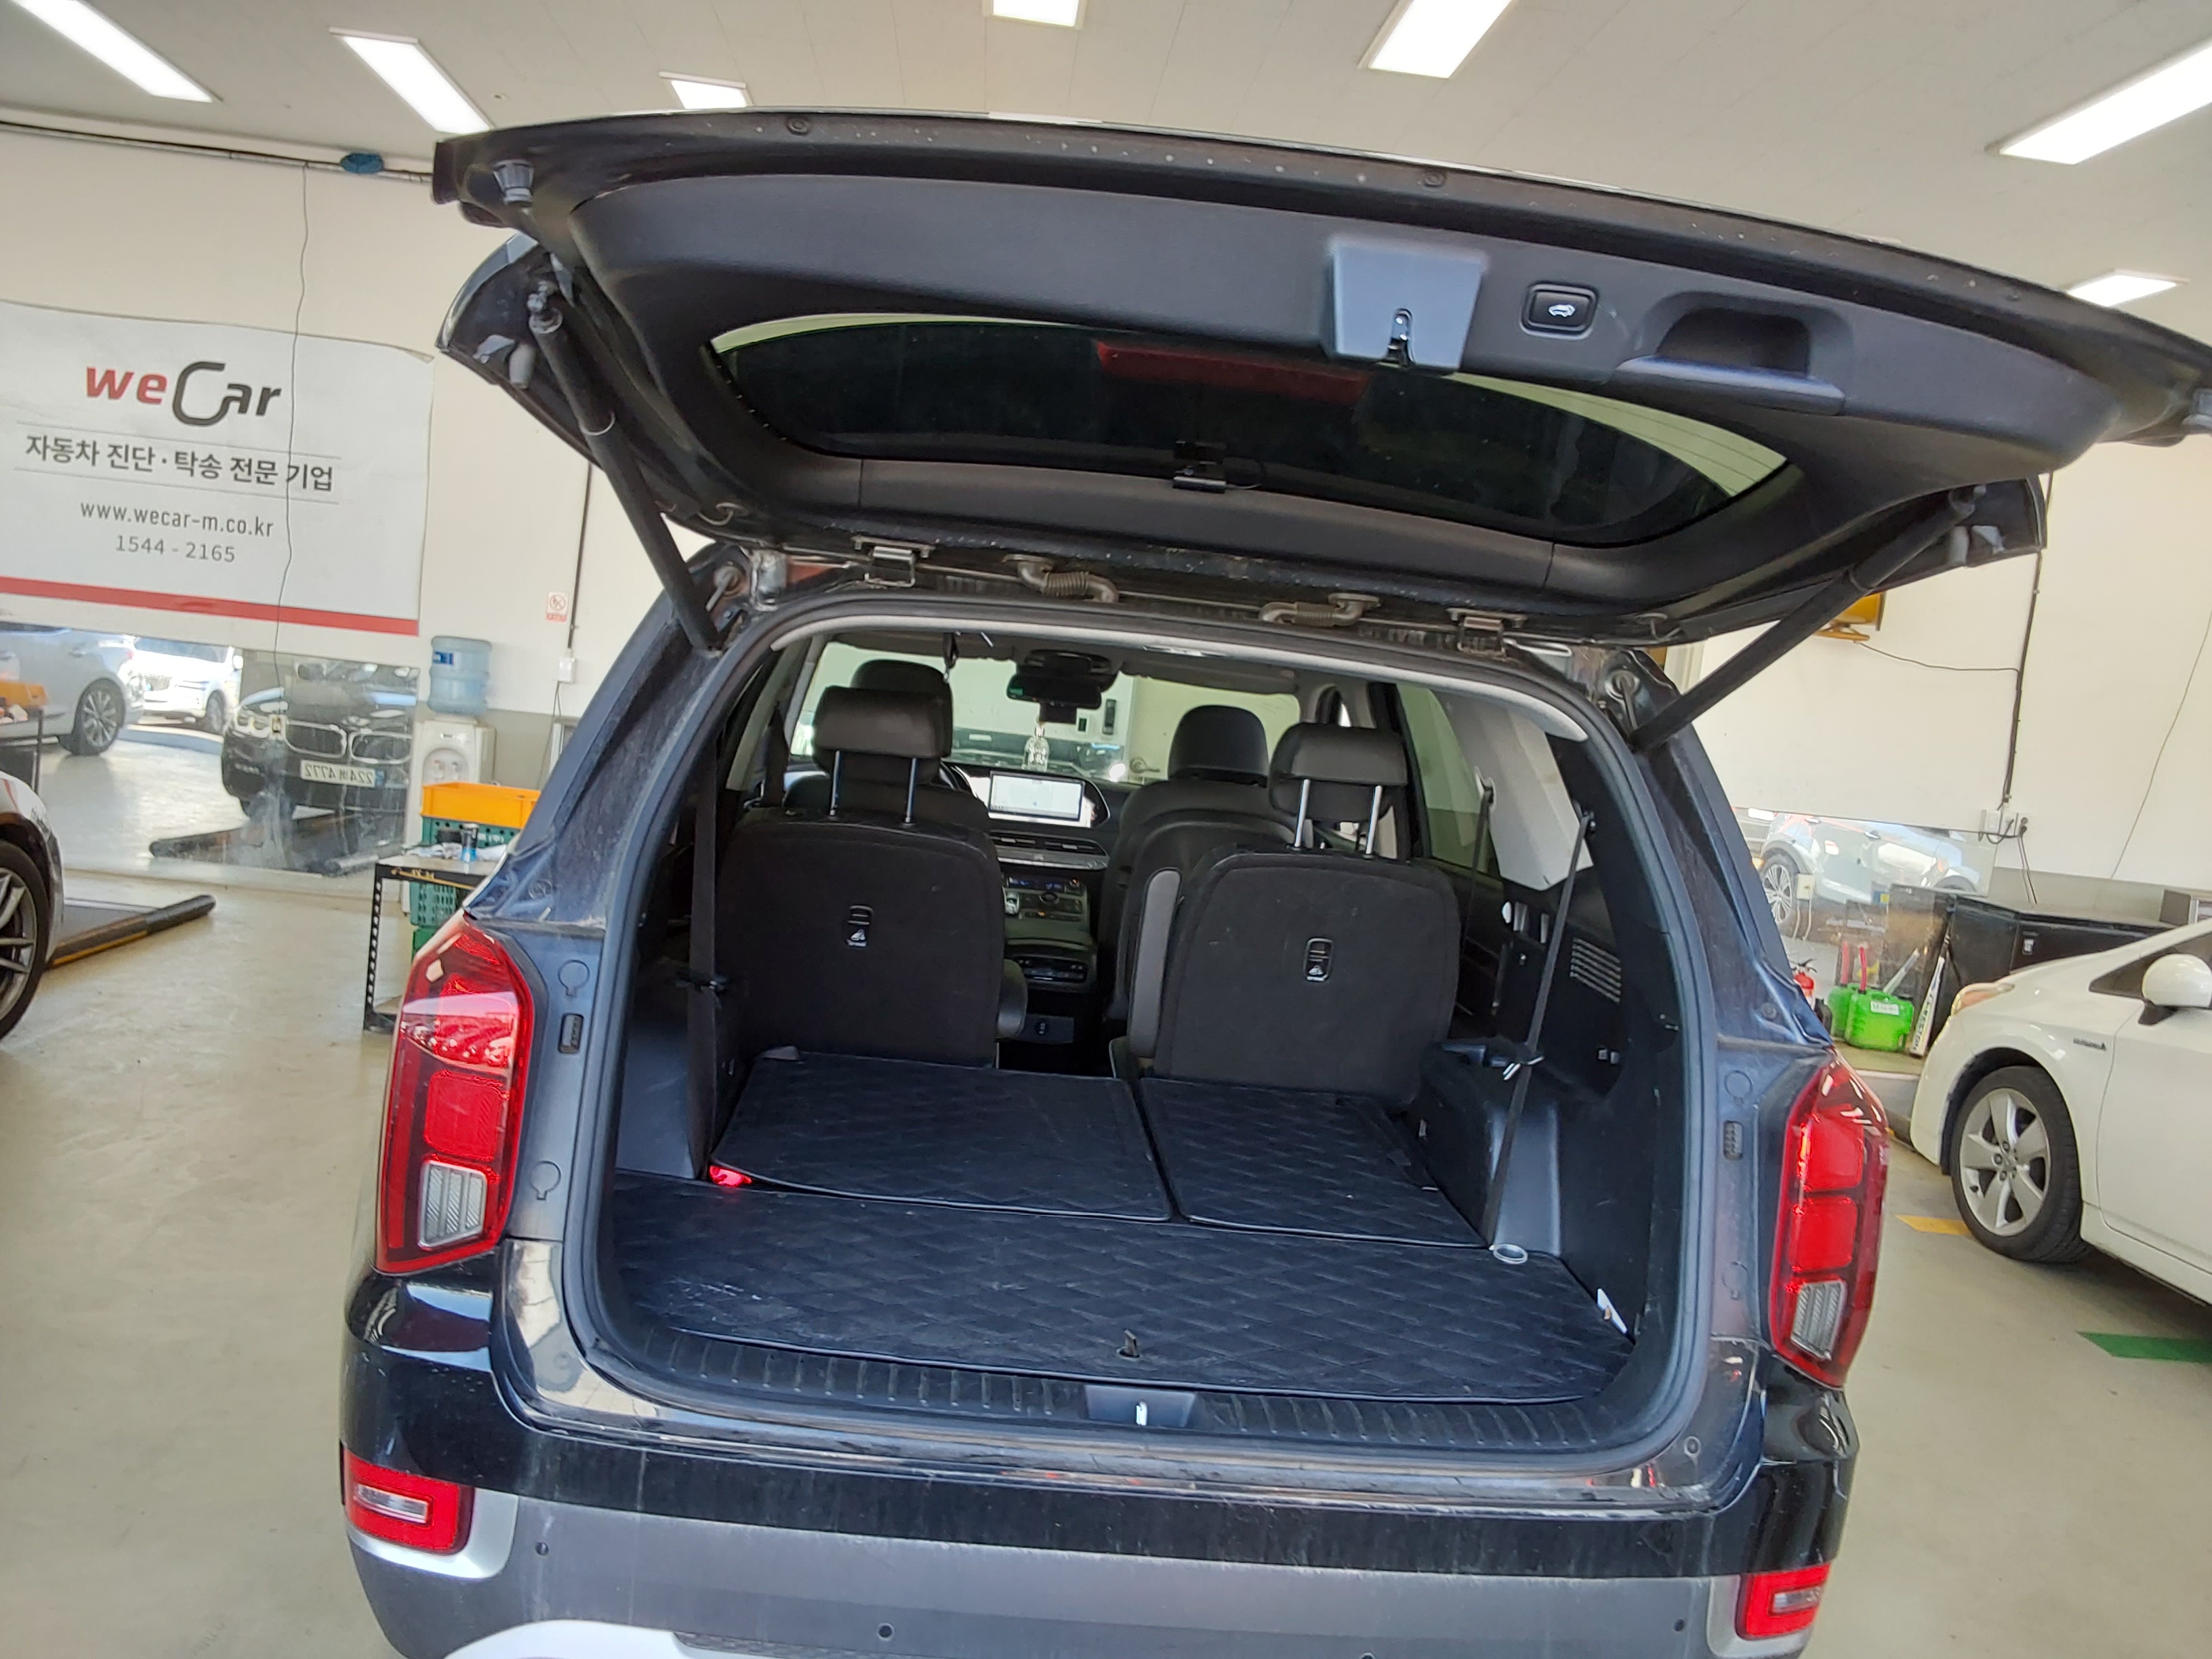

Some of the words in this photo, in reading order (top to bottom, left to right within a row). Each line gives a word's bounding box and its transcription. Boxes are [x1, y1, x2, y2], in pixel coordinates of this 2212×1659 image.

[86, 361, 282, 428] weCar
[26, 434, 100, 467] 자동차
[230, 457, 279, 486] 전문
[287, 464, 333, 492] 기업
[81, 503, 274, 537] www.wecar-m.co.kr
